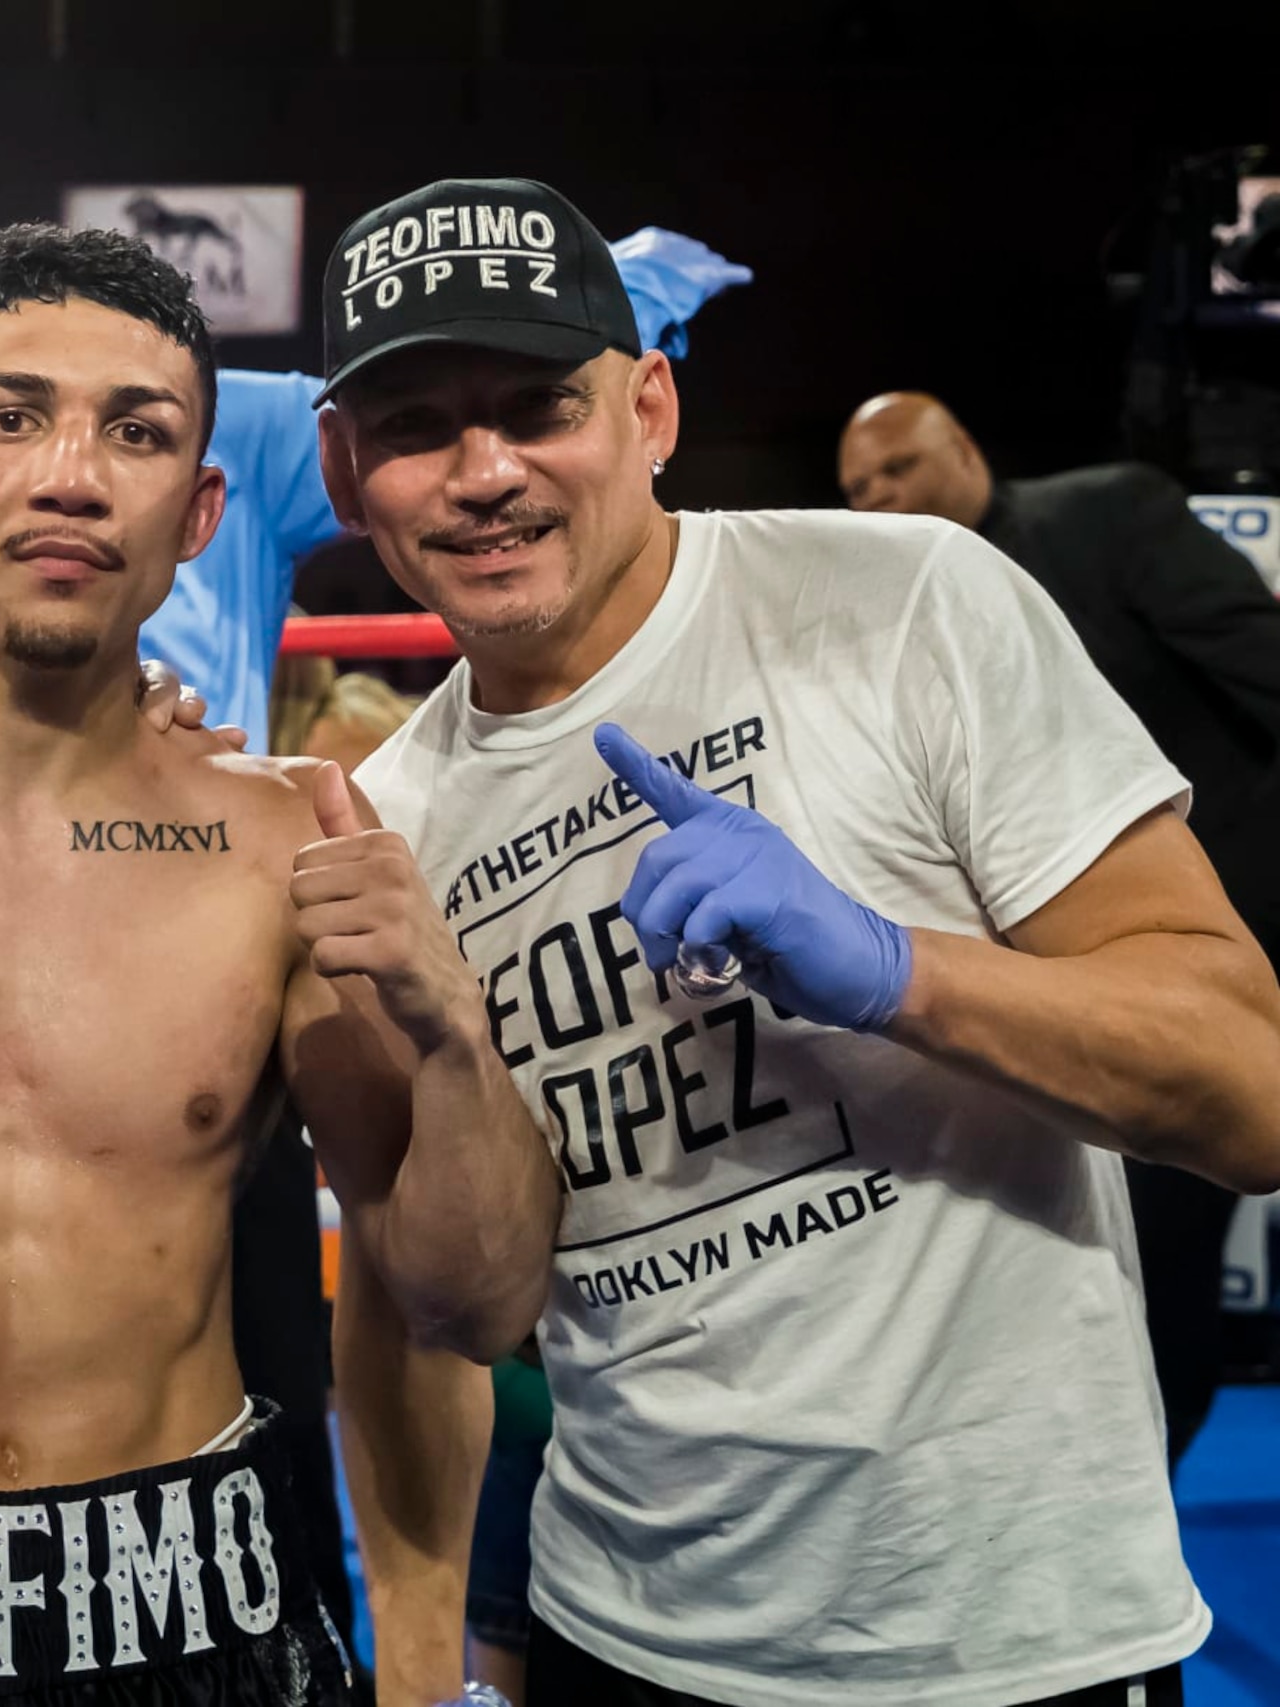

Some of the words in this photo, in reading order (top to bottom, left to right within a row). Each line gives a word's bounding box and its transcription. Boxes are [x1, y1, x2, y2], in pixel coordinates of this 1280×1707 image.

[344, 205, 556, 286] TEOFIMO
[344, 258, 558, 332] LOPEZ
[70, 820, 232, 852] MCMXVI
[444, 716, 768, 921] #THETAKEVER
[542, 997, 790, 1191] OPEZ
[572, 1232, 730, 1309] OOKLYN
[743, 1167, 900, 1260] MADE
